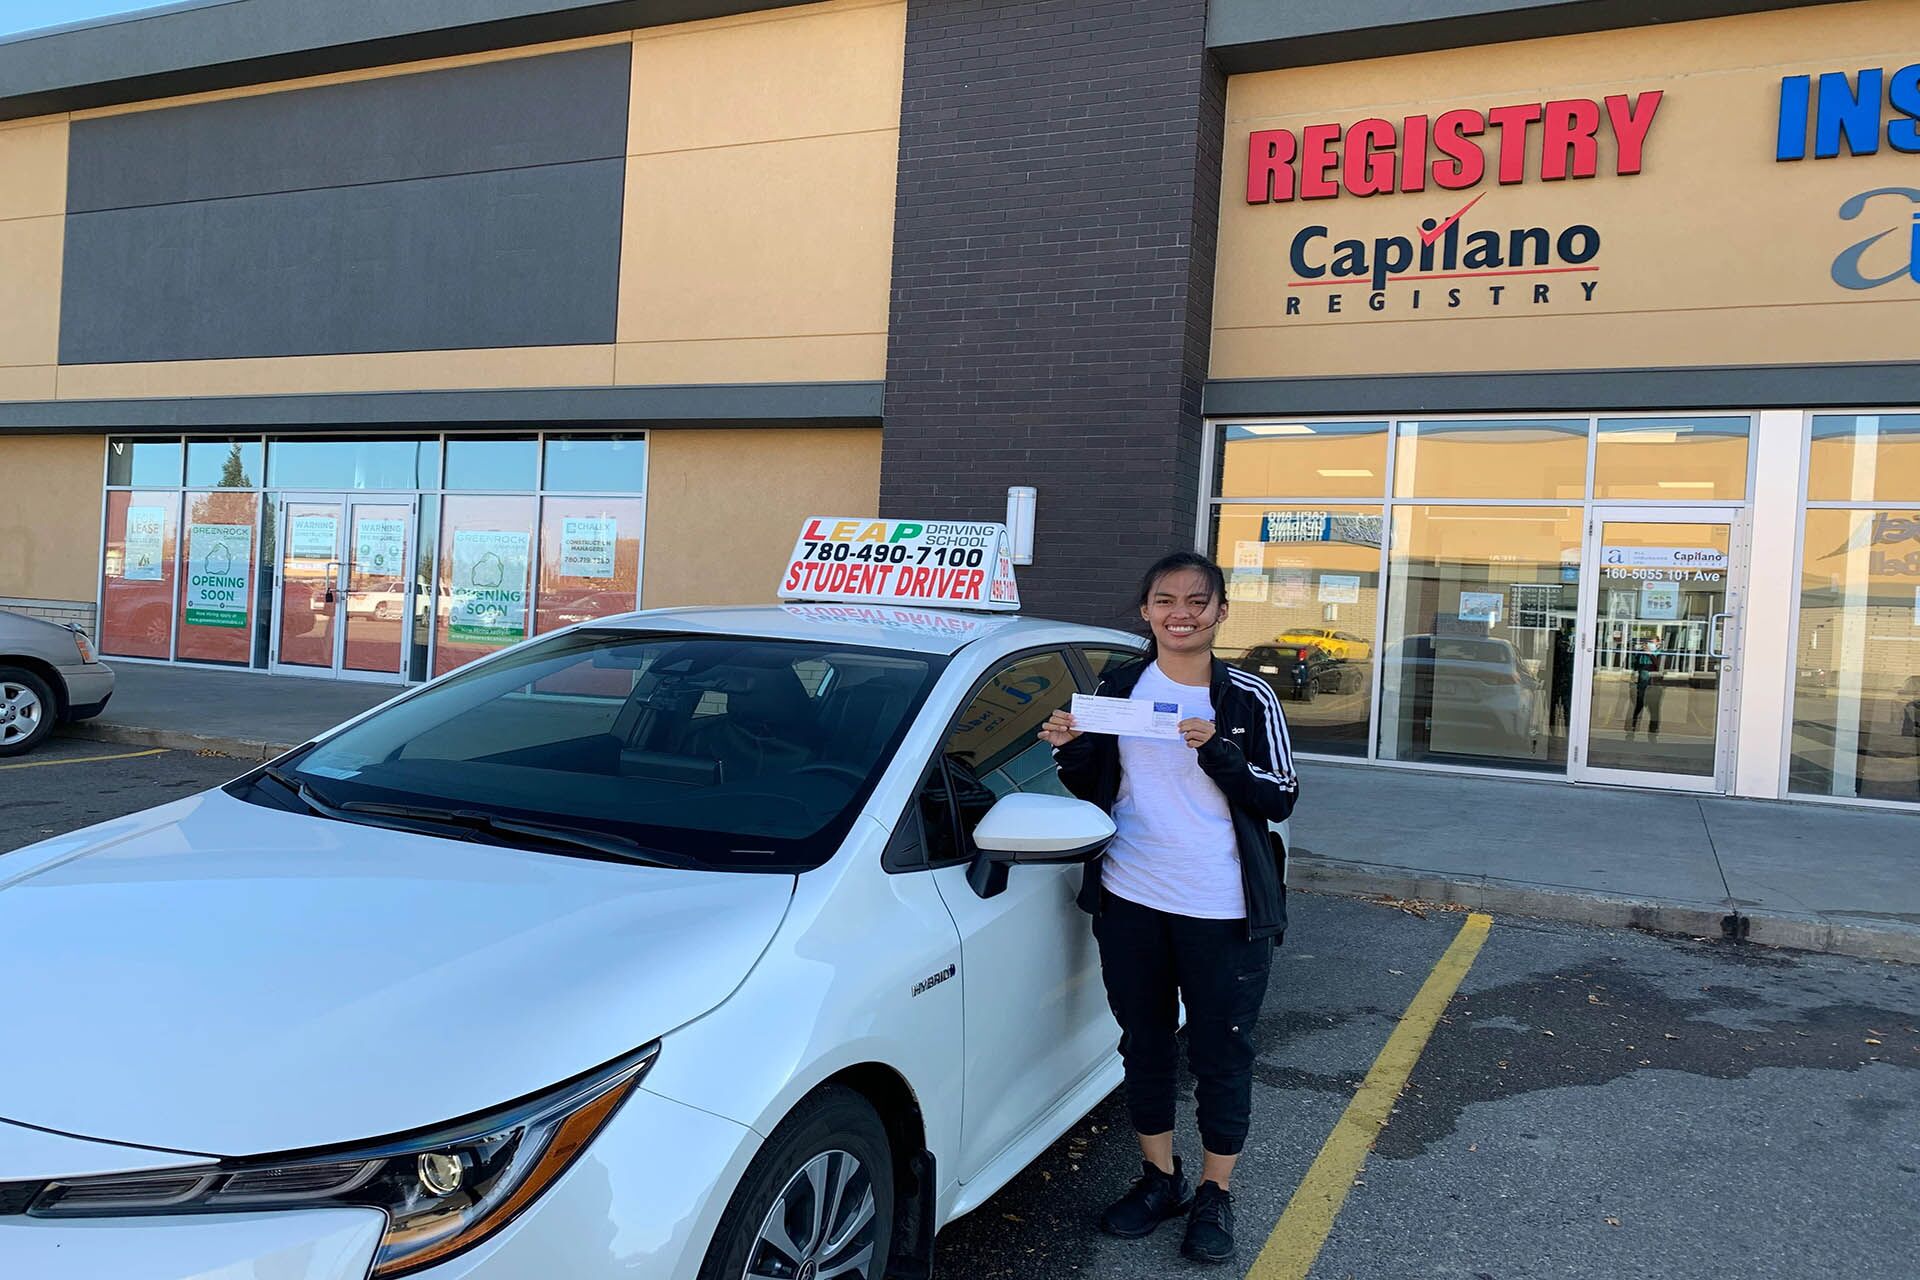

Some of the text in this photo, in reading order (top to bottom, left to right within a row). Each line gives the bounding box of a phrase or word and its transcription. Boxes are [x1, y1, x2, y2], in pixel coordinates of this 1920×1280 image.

[1247, 91, 1664, 204] REGISTRY
[1290, 216, 1600, 290] Capilano
[1286, 281, 1598, 315] REGISTRY
[131, 523, 159, 535] LEASE
[192, 527, 249, 536] GREENROCK
[295, 520, 335, 529] WARNING
[803, 520, 994, 543] LEAP DRIVING
[925, 535, 988, 547] SCHOOL
[803, 542, 983, 567] 780-490-7100
[1674, 551, 1723, 563] Capilano
[192, 575, 245, 588] OPENING
[786, 561, 985, 600] STUDENT DRIVER
[1604, 567, 1721, 582] 160-5055 101 Ave
[200, 589, 234, 601] SOON
[466, 603, 508, 617] SOON
[911, 968, 950, 997] HYBRID
